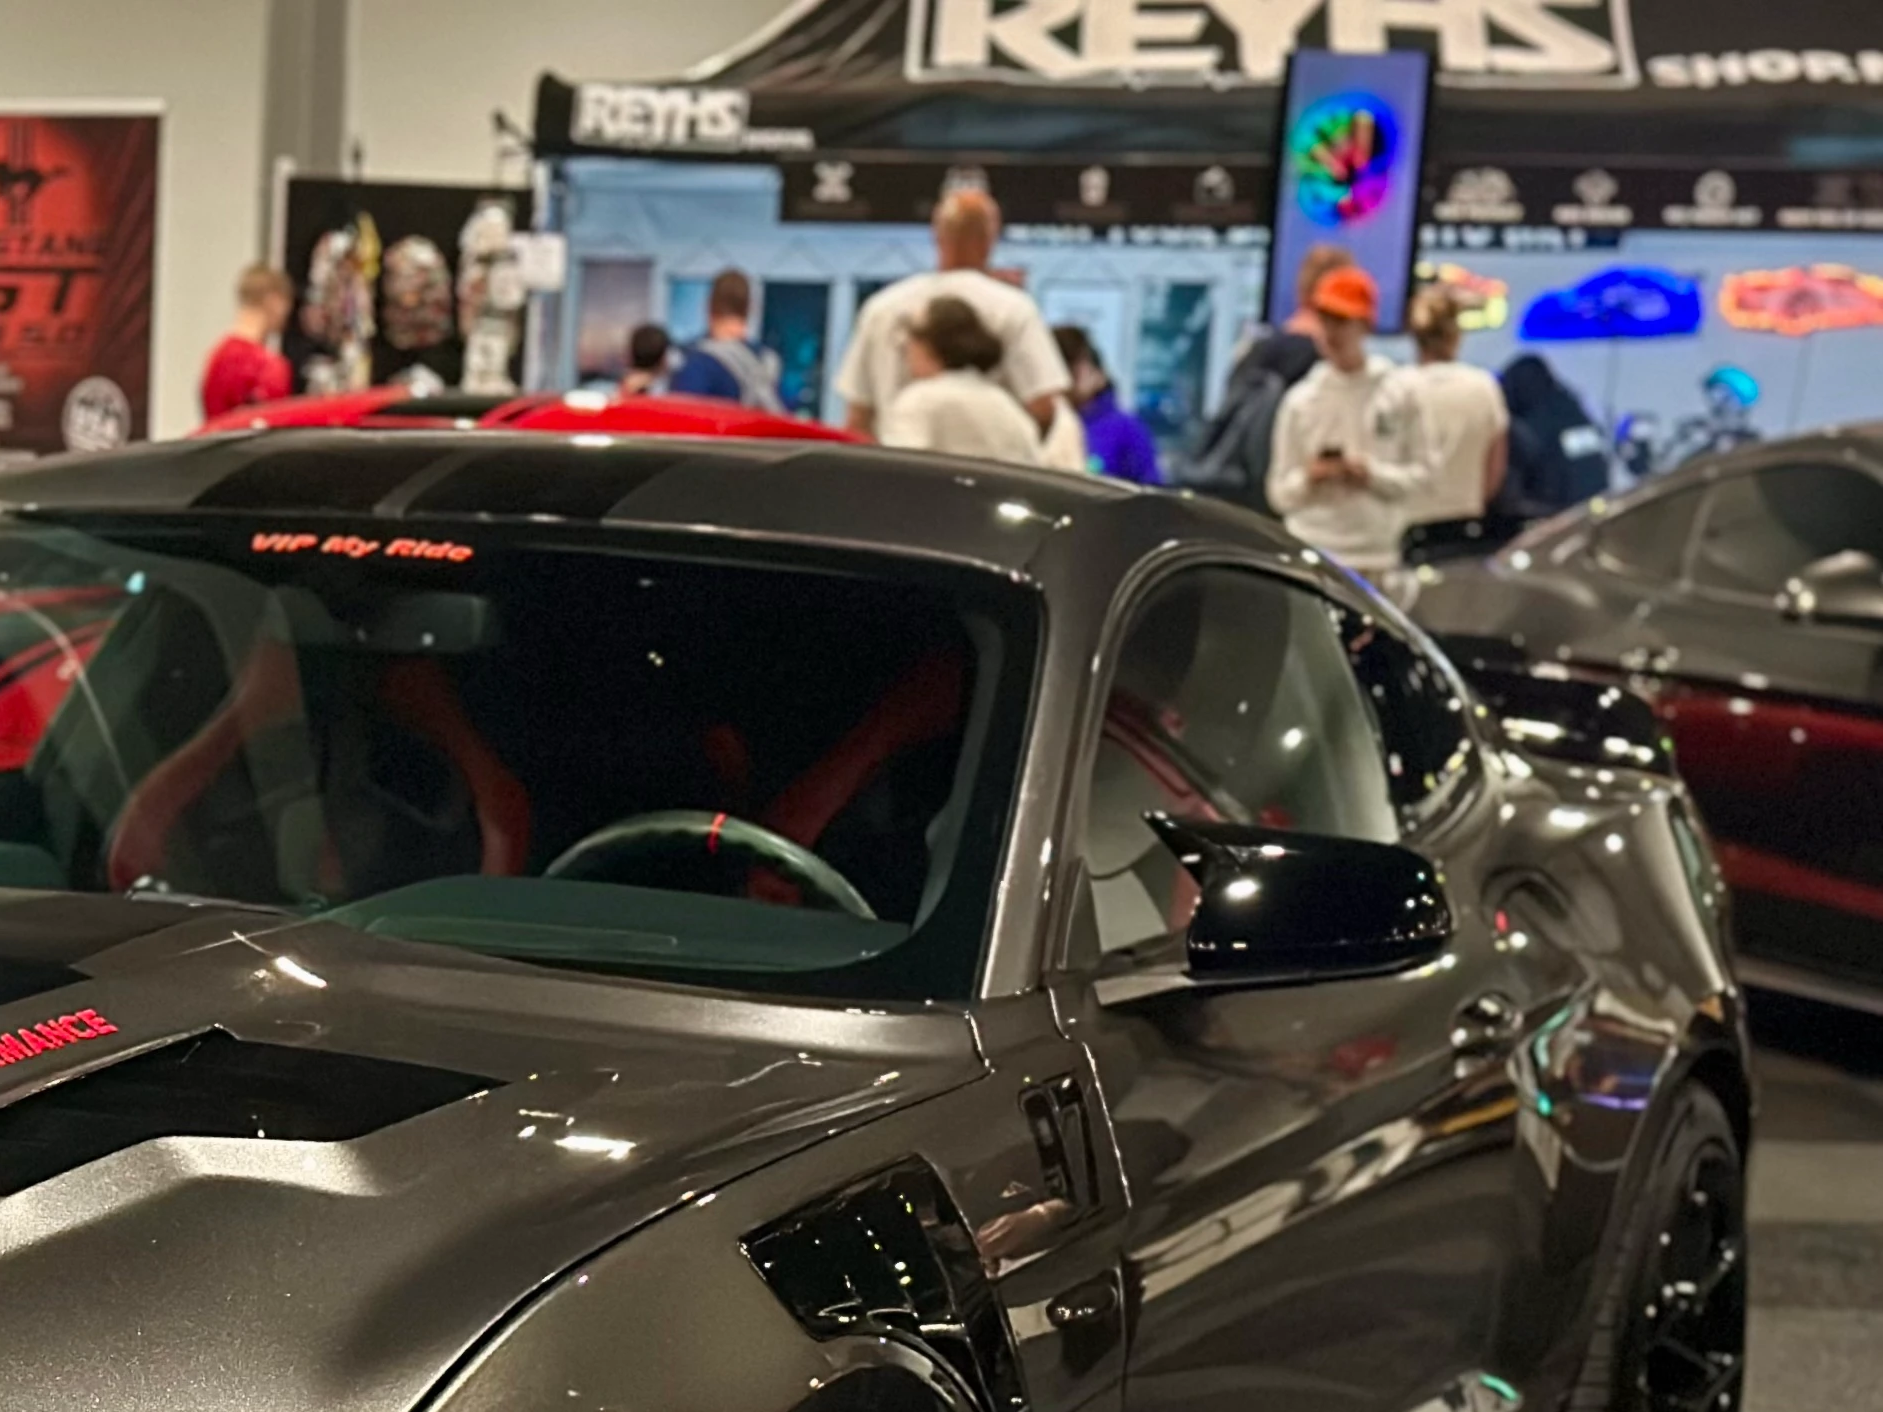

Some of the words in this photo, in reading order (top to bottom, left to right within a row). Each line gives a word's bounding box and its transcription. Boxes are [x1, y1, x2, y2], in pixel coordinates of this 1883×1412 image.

[573, 84, 744, 146] REYHS
[252, 532, 318, 552] VIP
[320, 534, 380, 558] My
[383, 537, 474, 563] Ride
